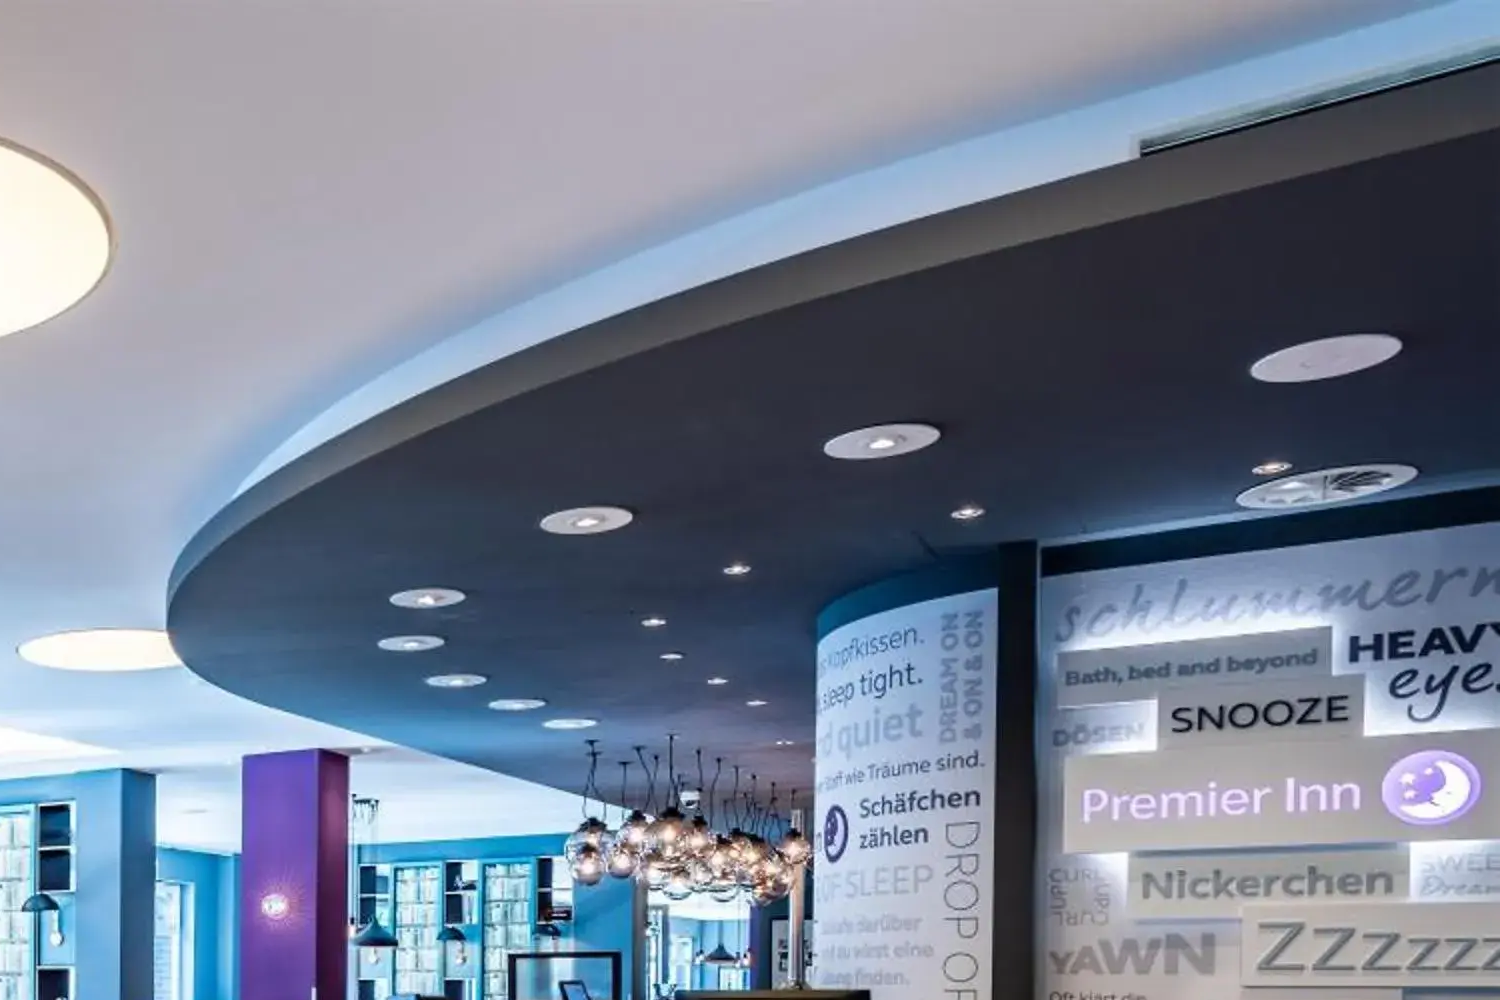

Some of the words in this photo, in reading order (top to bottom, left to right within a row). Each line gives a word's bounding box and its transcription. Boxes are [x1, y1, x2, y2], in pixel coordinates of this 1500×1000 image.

[940, 612, 959, 648] ON
[964, 610, 984, 648] ON
[860, 662, 924, 698] tight.
[1065, 667, 1122, 687] Bath,
[1128, 662, 1170, 681] bed
[1177, 658, 1218, 676] and
[1221, 649, 1317, 674] beyond
[939, 657, 958, 745] DREAM
[964, 678, 984, 718] ON
[1389, 662, 1500, 722] eye
[838, 702, 924, 761] quiet
[1171, 695, 1350, 733] SNOOZE
[1053, 722, 1145, 747] DÖSEN
[868, 758, 931, 783] Träume
[937, 750, 986, 771] sind.
[859, 789, 981, 818] Schäfchen
[1081, 782, 1272, 824] Premier
[1286, 777, 1361, 812] Inn
[859, 825, 929, 849] zählen
[845, 865, 934, 899] SLEEP
[944, 821, 980, 938] DROP
[1049, 868, 1101, 884] CURL
[1142, 866, 1394, 900] Nickerchen
[1049, 932, 1216, 976] YAWN
